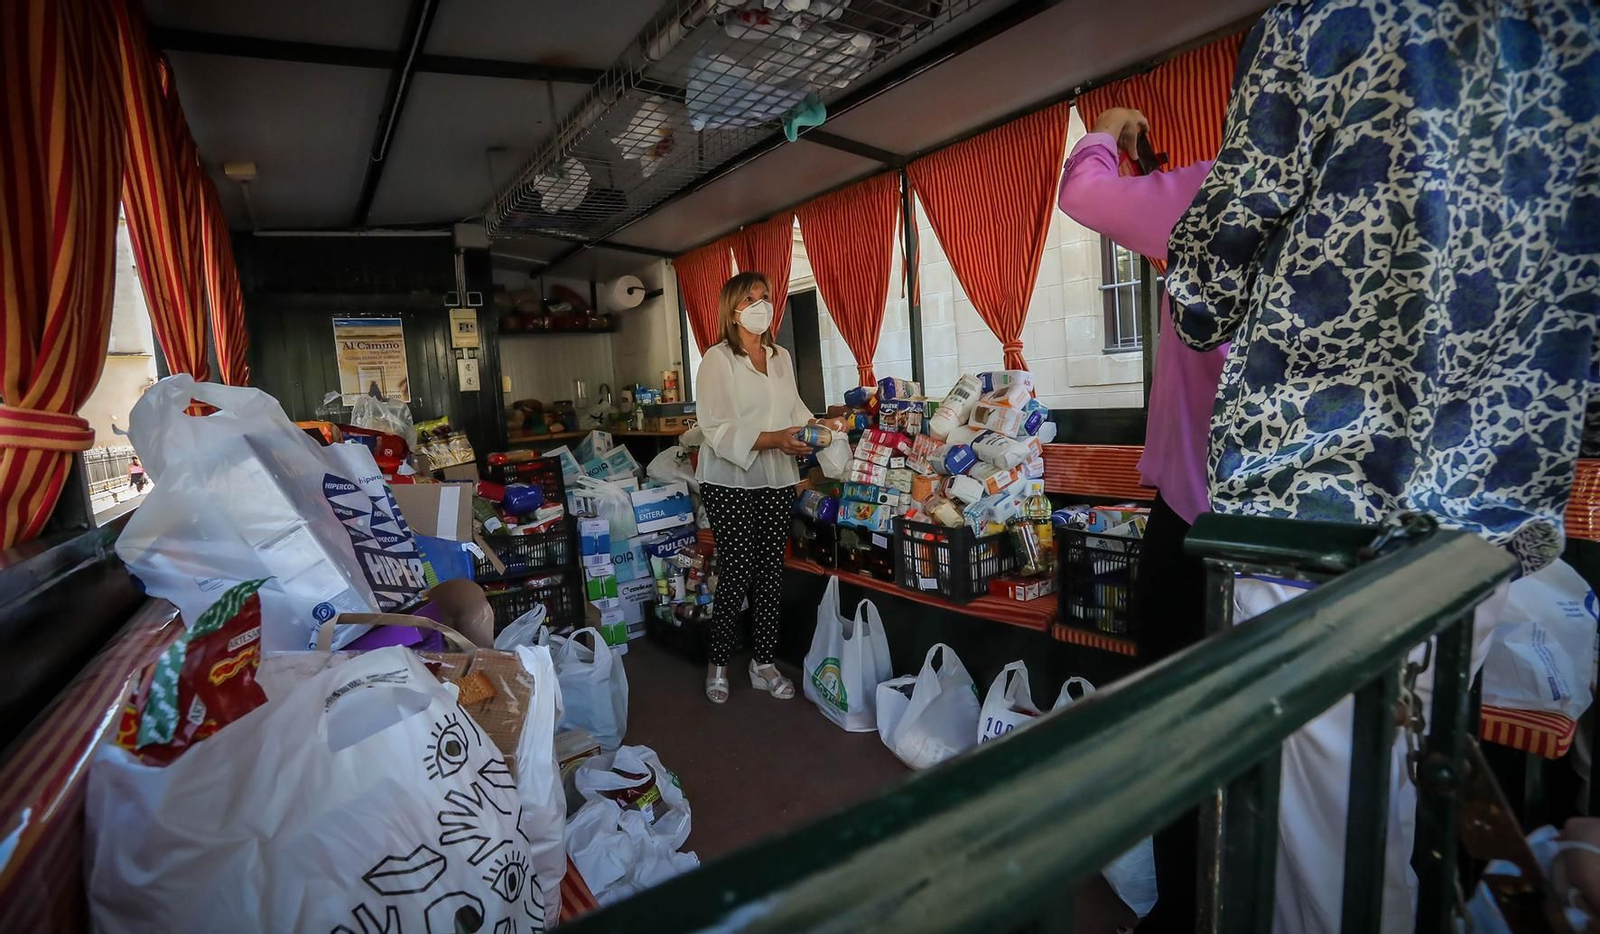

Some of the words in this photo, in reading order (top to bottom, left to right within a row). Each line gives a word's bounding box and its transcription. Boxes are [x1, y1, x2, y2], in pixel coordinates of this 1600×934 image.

[343, 342, 356, 350] Al
[357, 341, 400, 350] Camino
[358, 474, 385, 485] hiperco
[325, 482, 356, 491] HIPERCOR
[638, 509, 665, 521] ENTERA
[657, 535, 696, 554] PULEVA
[363, 552, 428, 589] HIPER
